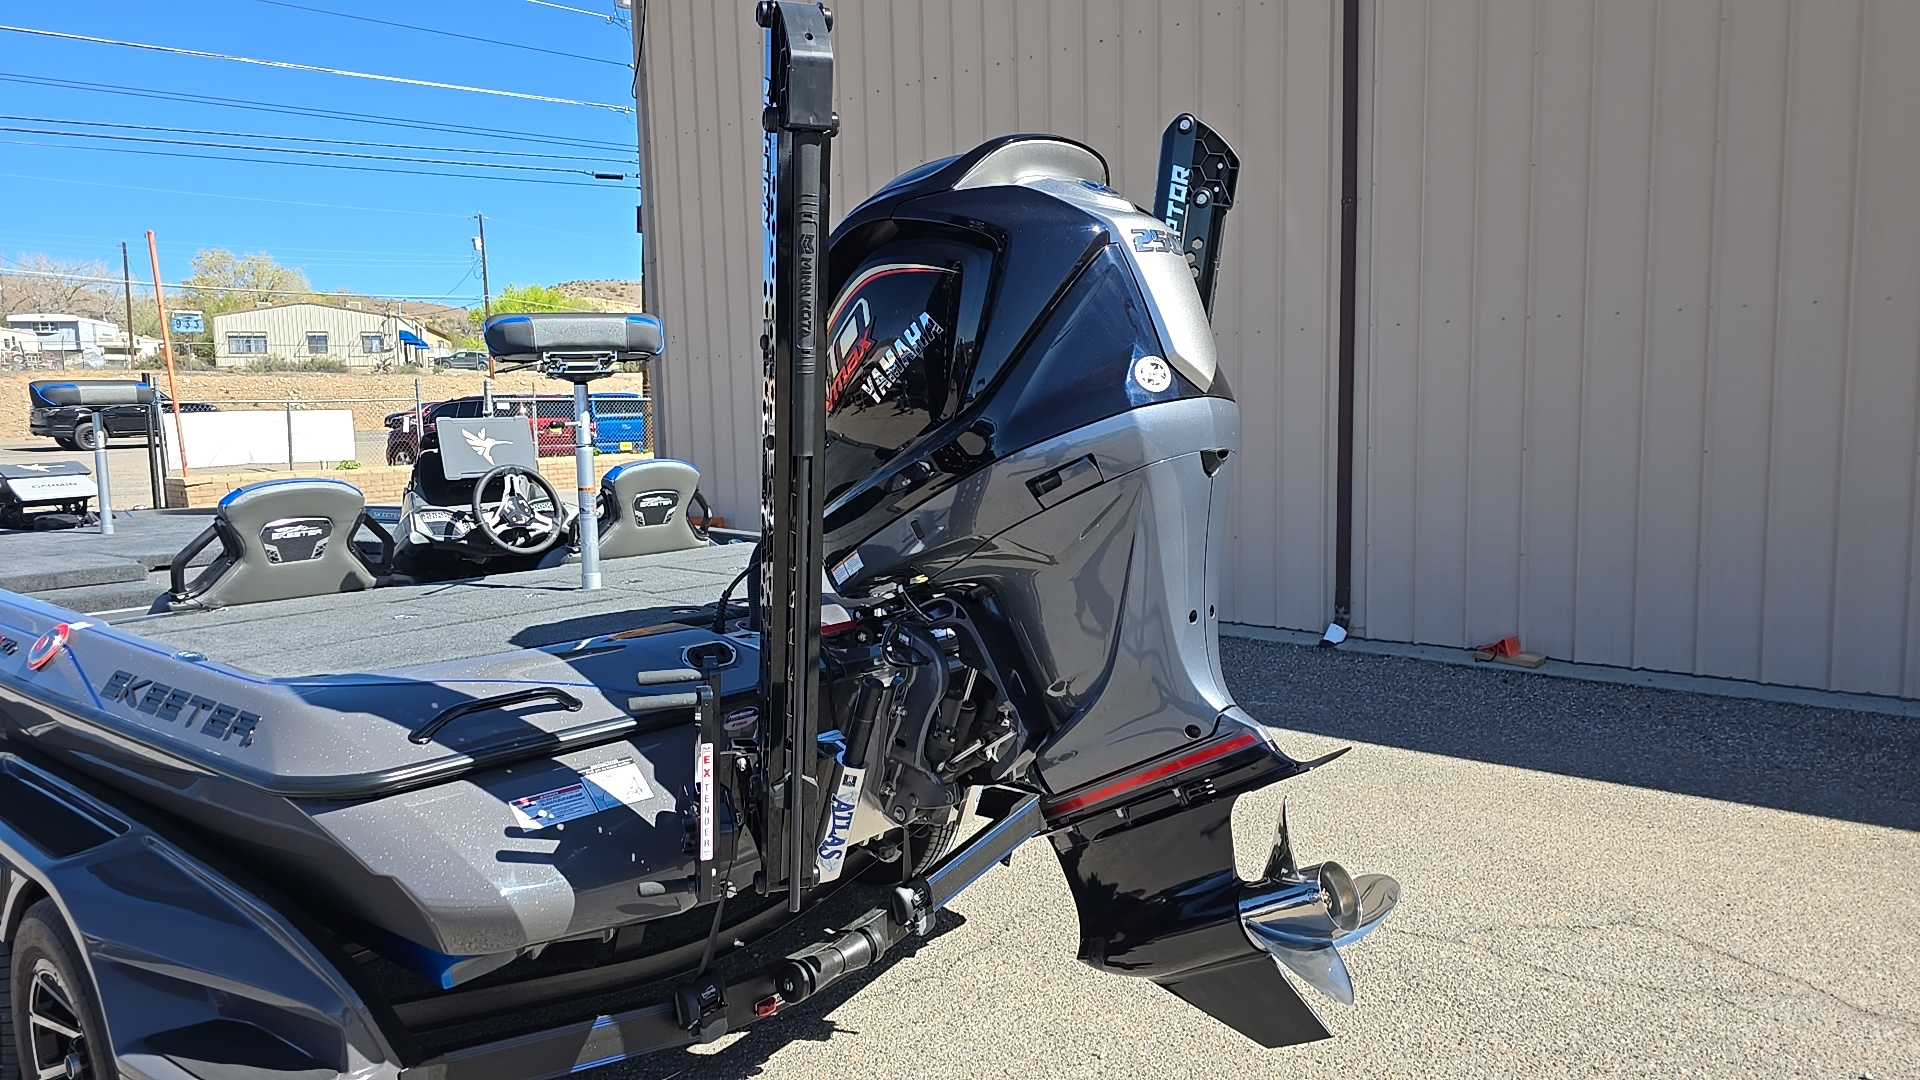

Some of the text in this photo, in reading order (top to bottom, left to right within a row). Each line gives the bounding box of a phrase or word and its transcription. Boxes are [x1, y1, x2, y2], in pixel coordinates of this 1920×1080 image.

[1165, 164, 1191, 238] PTOR
[175, 319, 200, 329] 933
[861, 311, 944, 404] YAMAHA
[99, 669, 263, 748] SKEETER
[818, 793, 856, 861] ATLAS
